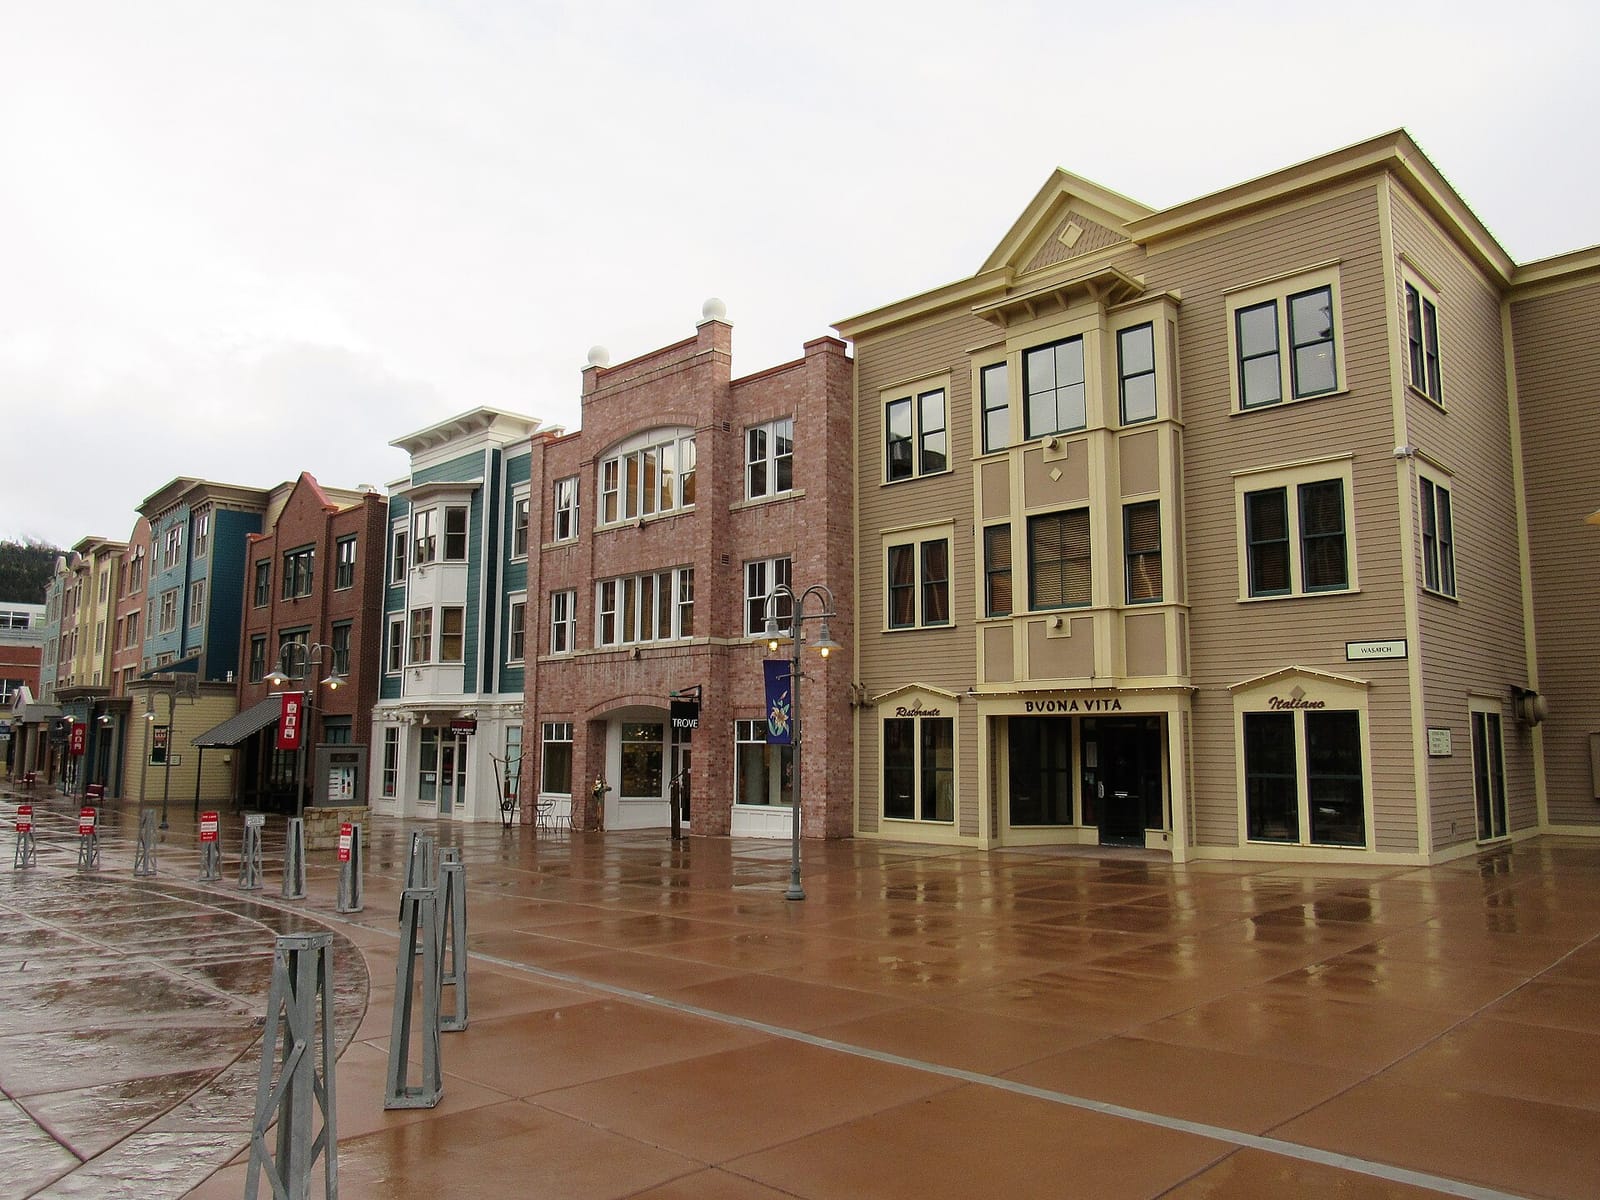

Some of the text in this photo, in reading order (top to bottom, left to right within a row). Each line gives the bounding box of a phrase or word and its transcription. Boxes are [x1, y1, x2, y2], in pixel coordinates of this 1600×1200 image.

[1360, 646, 1392, 654] WASATCH
[1084, 699, 1122, 711] VITA
[1268, 696, 1326, 710] Italiano
[895, 706, 941, 717] Ristorante
[672, 718, 699, 728] TROVE
